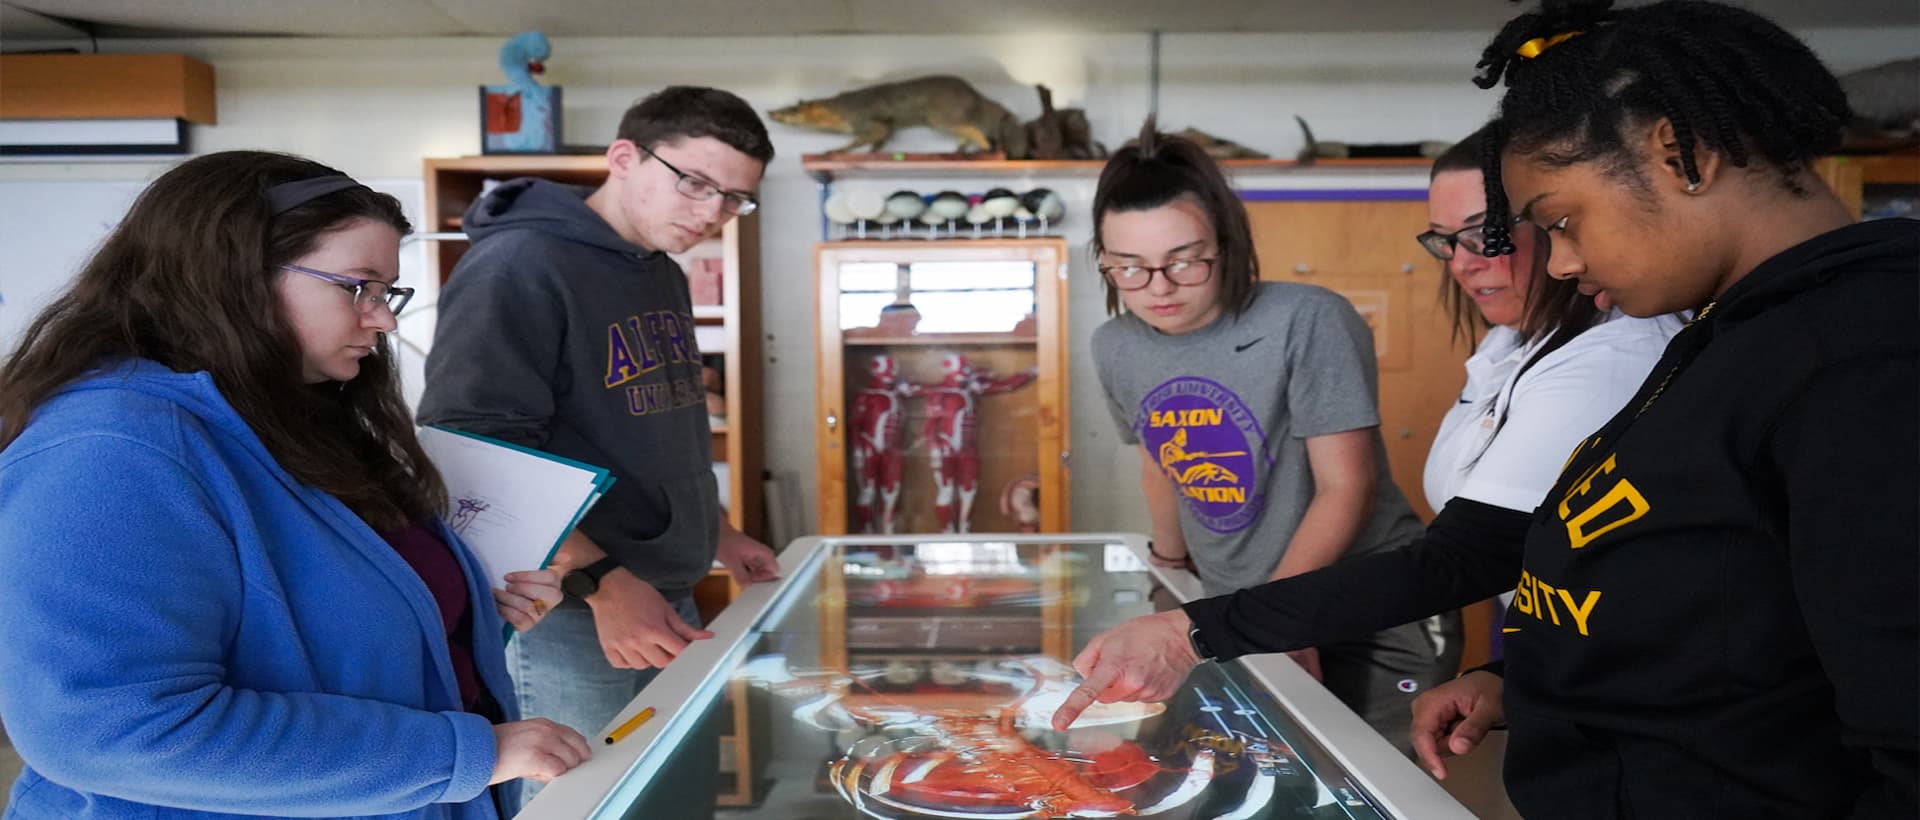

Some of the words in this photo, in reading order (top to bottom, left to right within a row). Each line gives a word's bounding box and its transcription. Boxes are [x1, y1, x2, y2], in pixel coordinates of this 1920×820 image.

[1149, 408, 1223, 428] SAXON
[1554, 437, 1651, 549] ED
[1513, 569, 1602, 634] SITY
